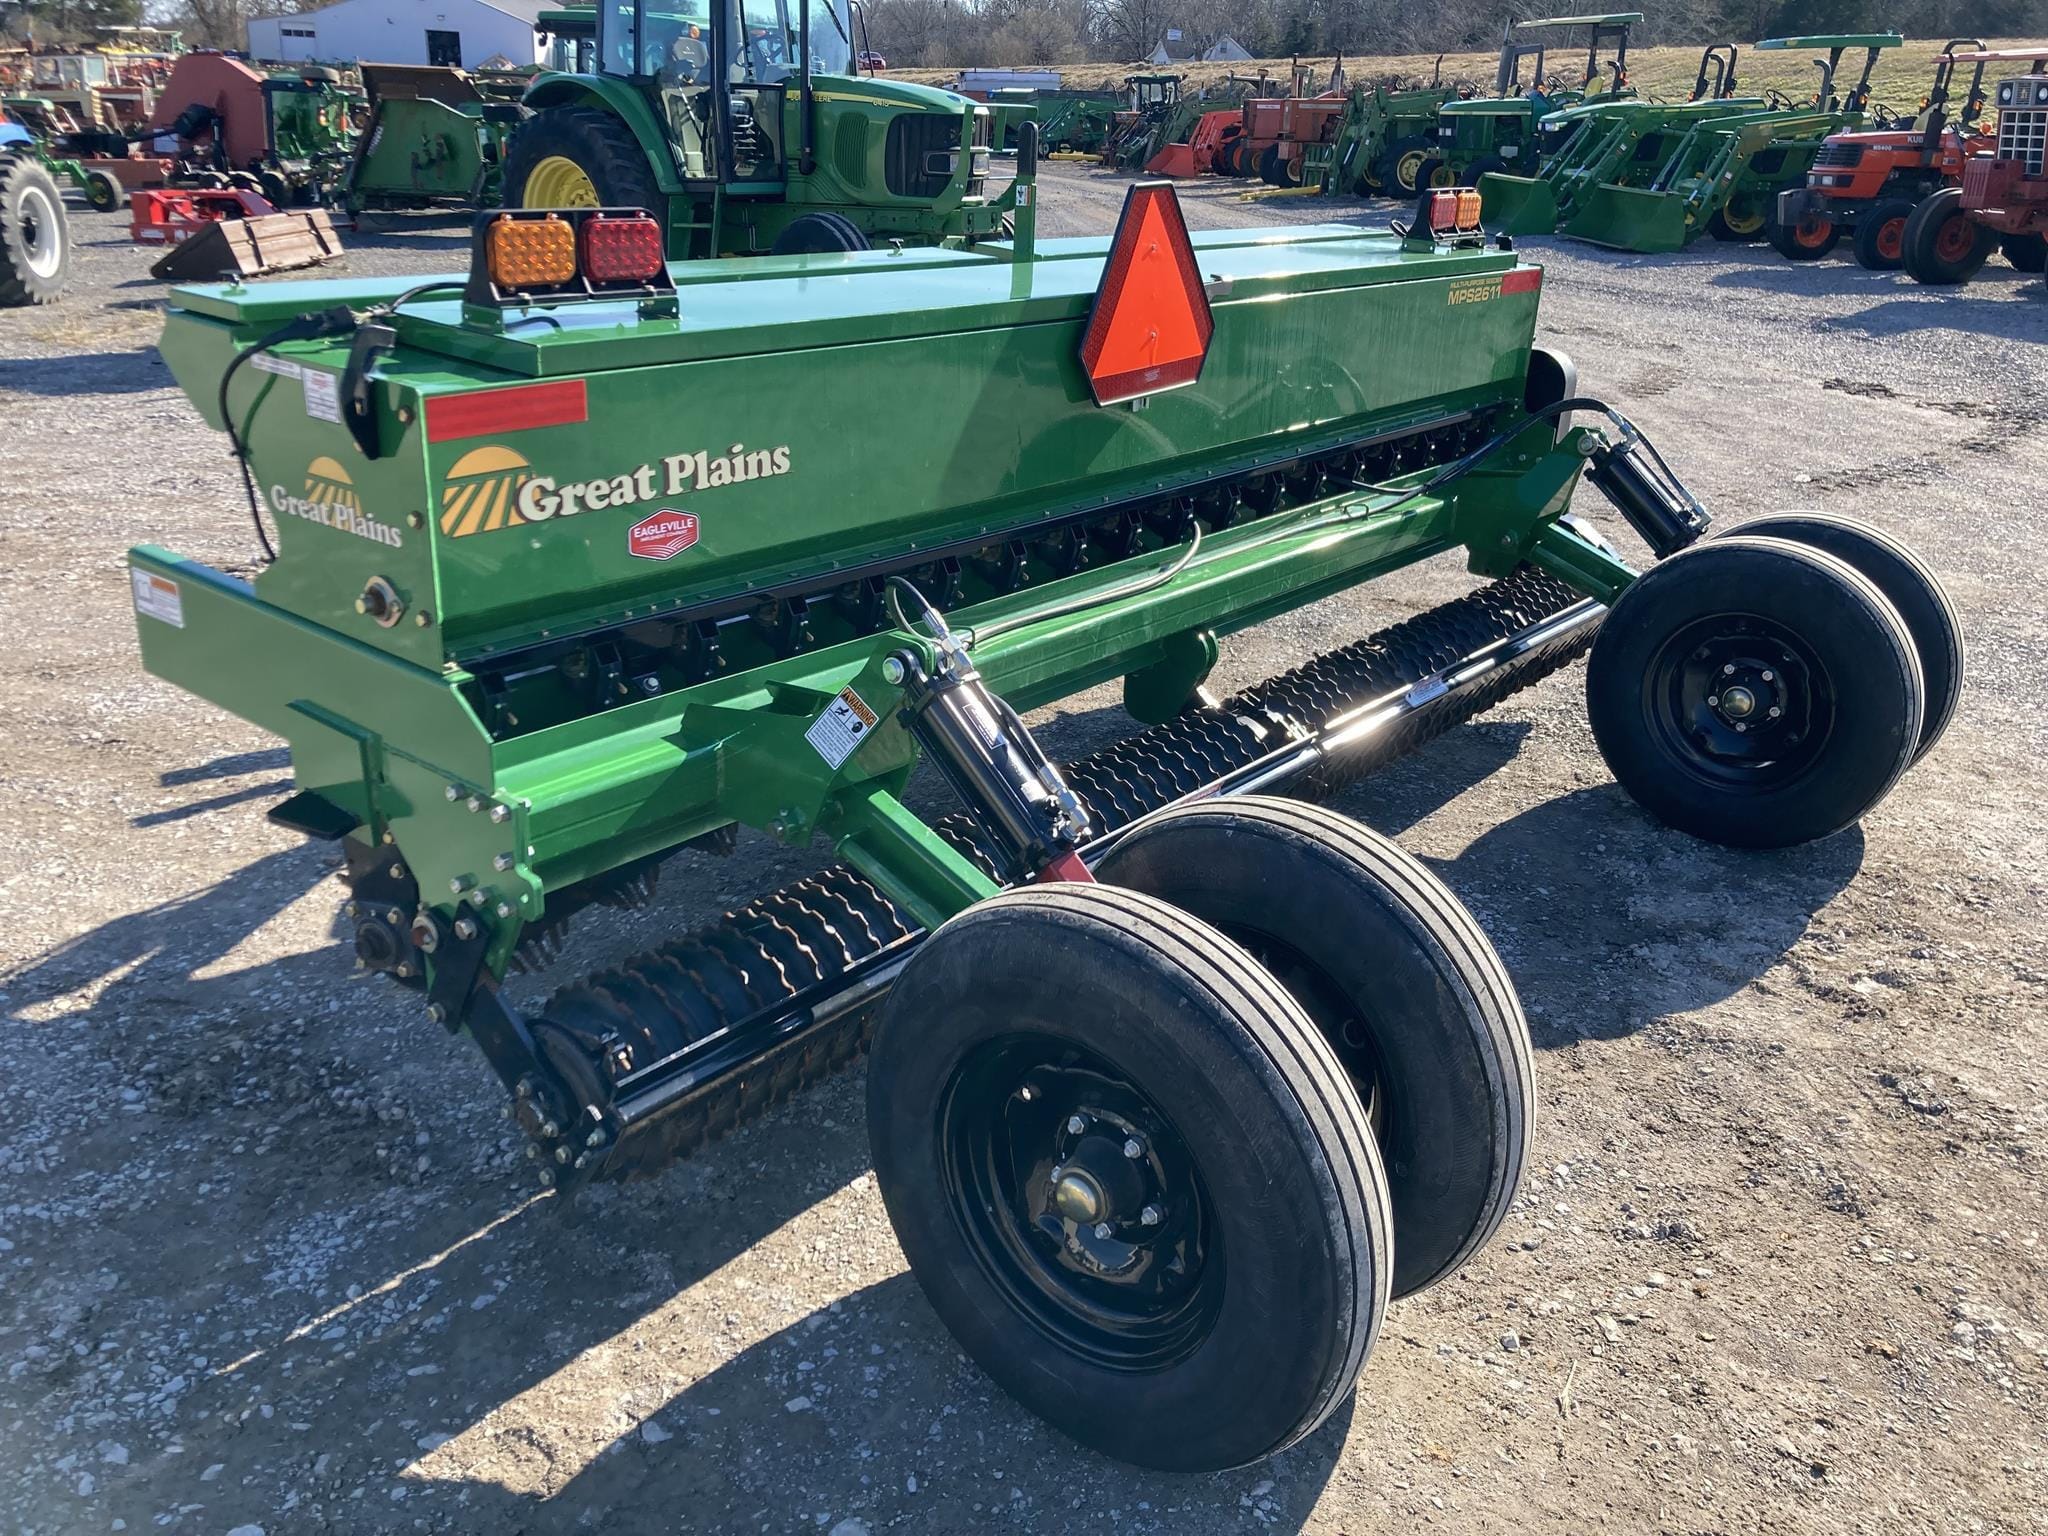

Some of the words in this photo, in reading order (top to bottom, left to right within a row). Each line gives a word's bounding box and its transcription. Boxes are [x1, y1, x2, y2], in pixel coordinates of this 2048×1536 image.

[1447, 285, 1501, 306] MPS2611
[516, 464, 657, 522] Great
[660, 443, 793, 496] Plains
[270, 484, 331, 526] Great
[332, 502, 402, 548] Plains
[633, 518, 694, 538] EAGLEVILLE
[847, 693, 875, 726] WARNING
